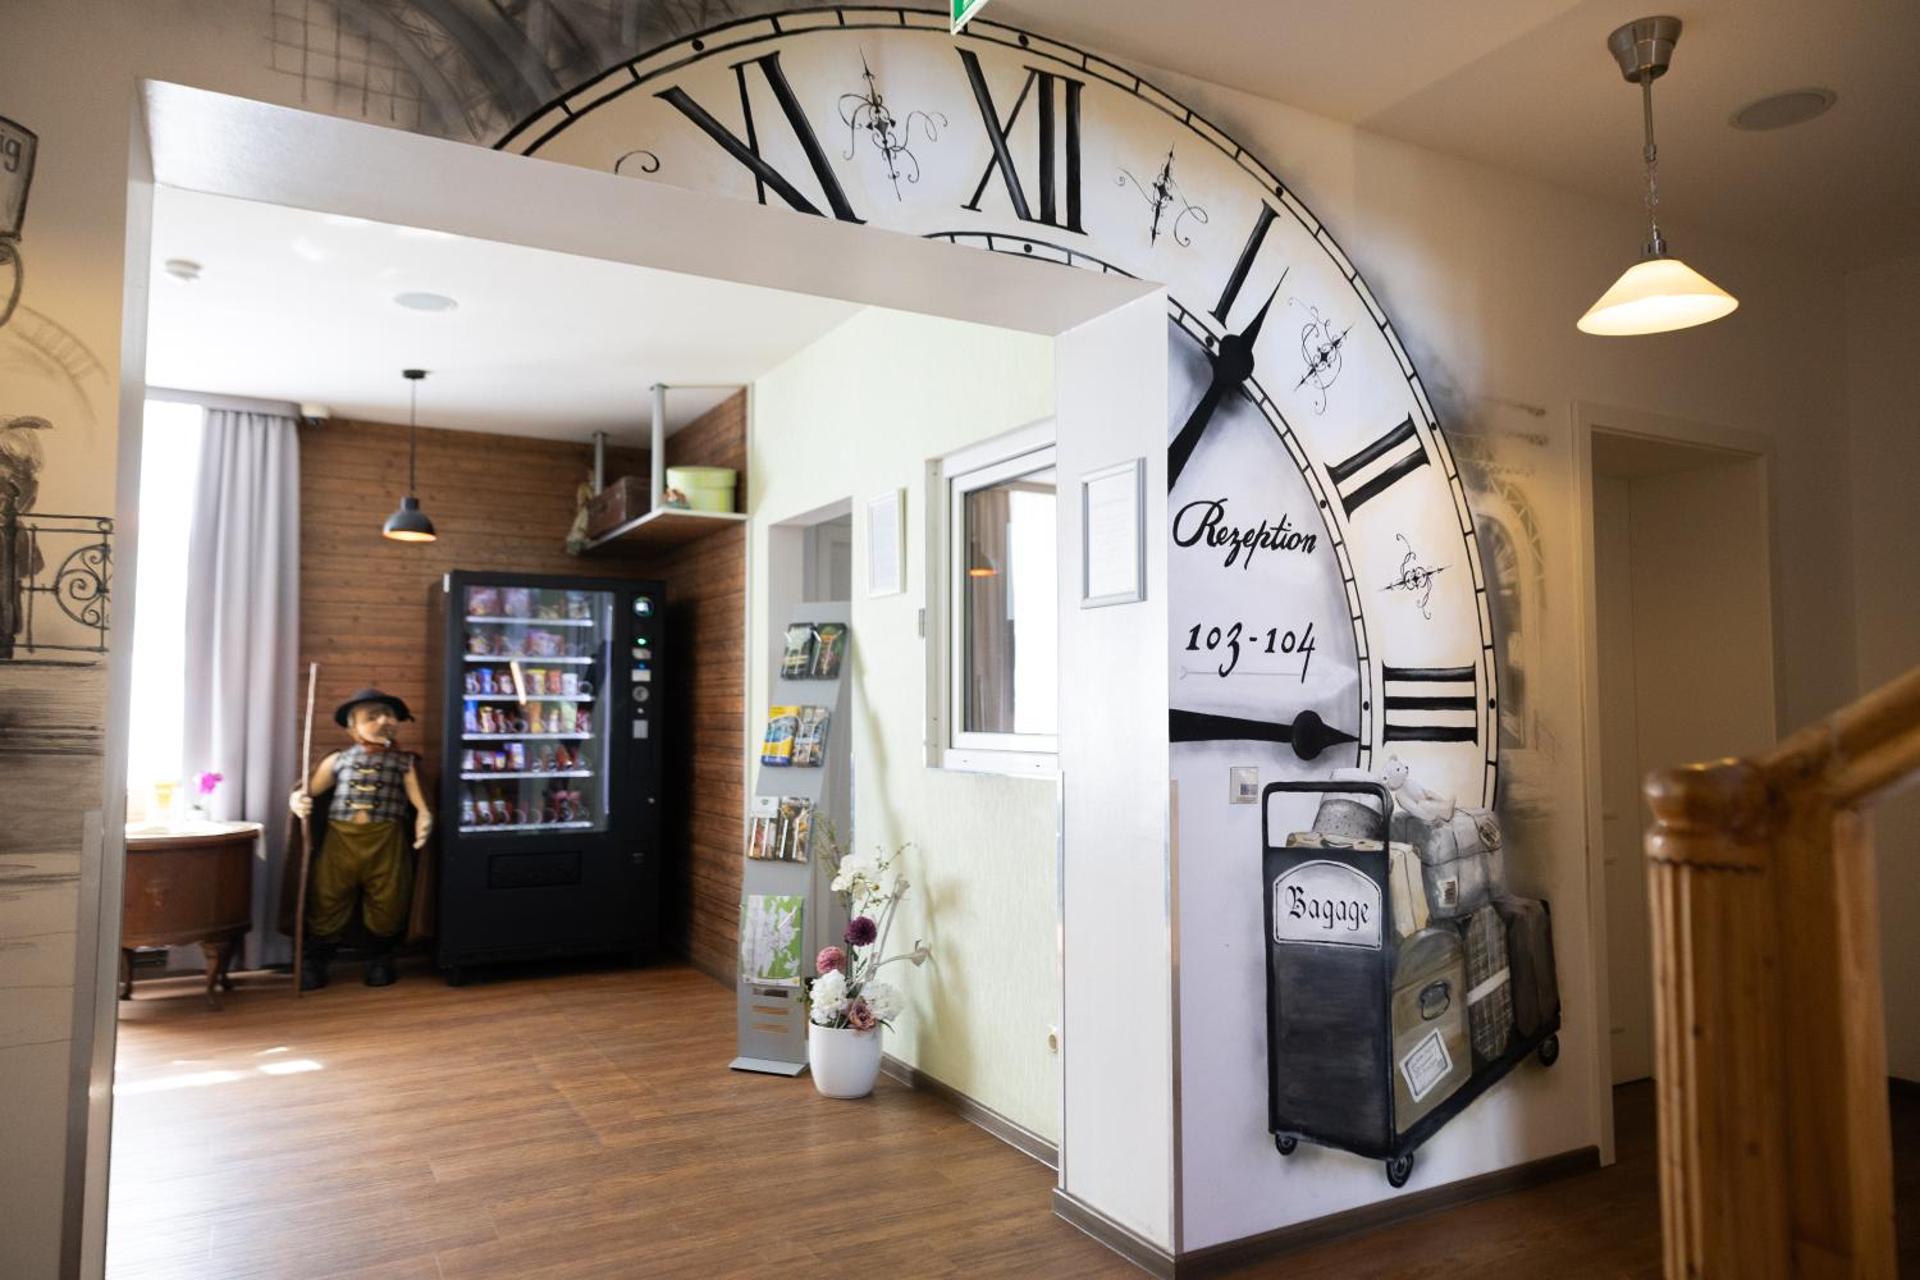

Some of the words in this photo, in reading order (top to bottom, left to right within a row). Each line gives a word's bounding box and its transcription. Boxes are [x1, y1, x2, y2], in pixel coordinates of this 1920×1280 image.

[955, 46, 1088, 234] XII
[1322, 412, 1431, 523] II
[1173, 498, 1317, 570] Rezeption
[1382, 661, 1478, 746] III
[1285, 885, 1369, 931] Bagage
